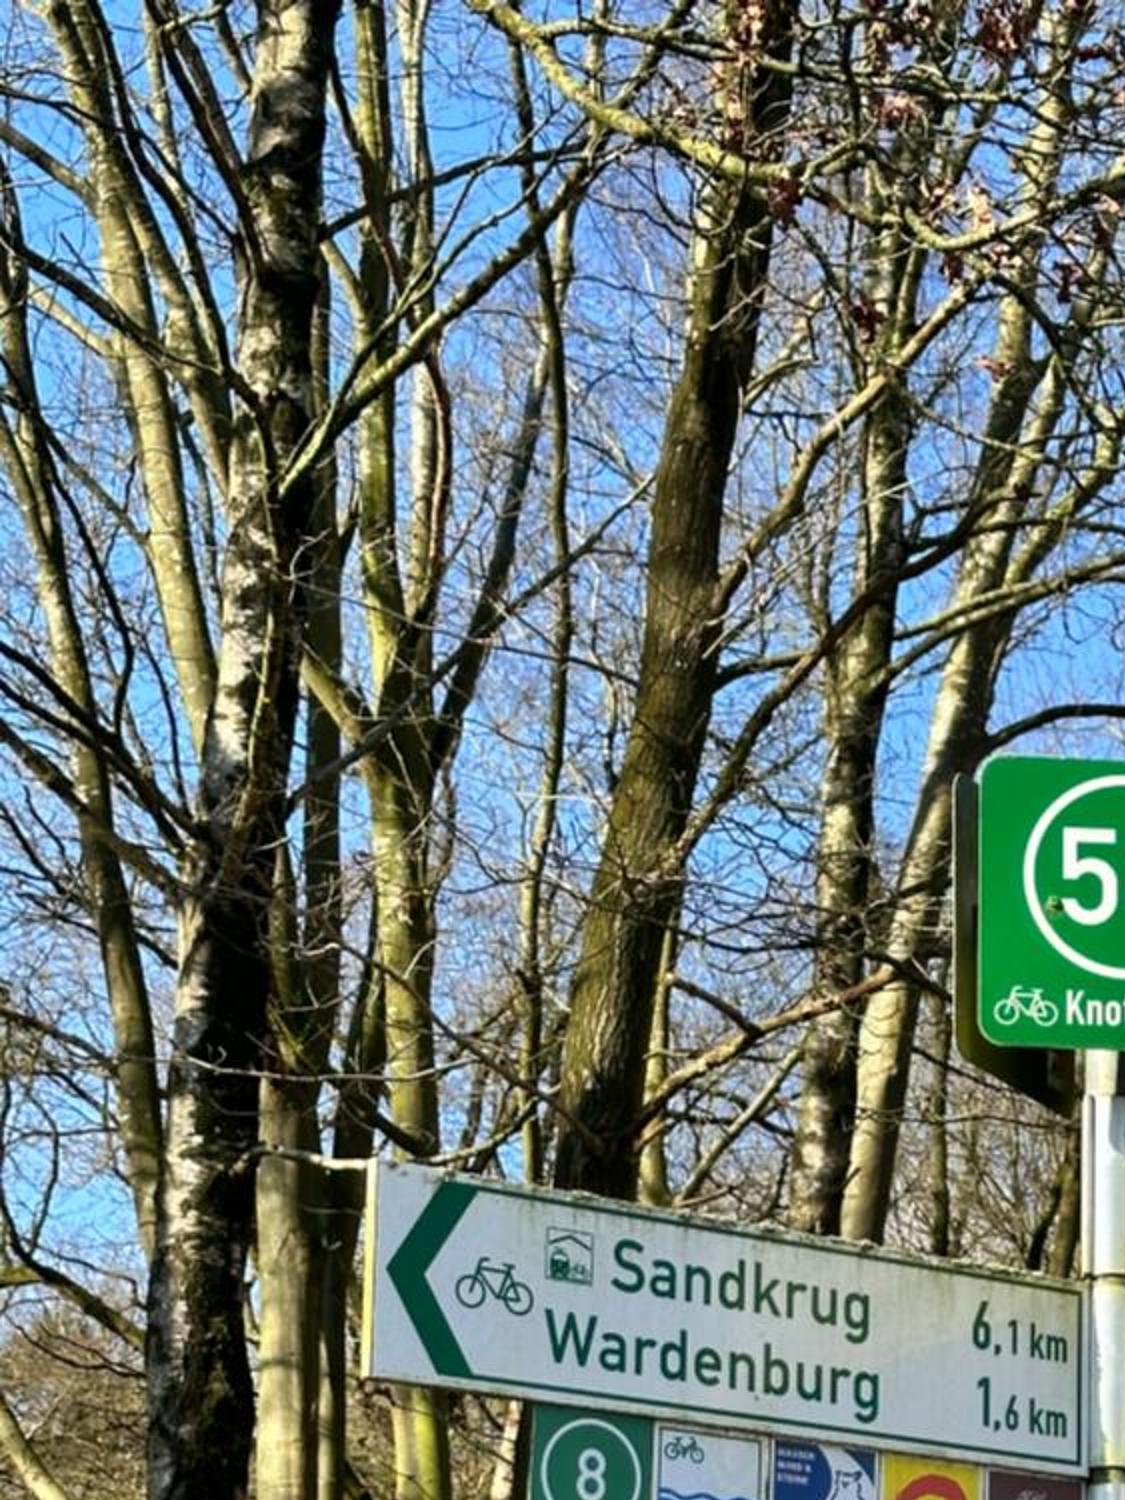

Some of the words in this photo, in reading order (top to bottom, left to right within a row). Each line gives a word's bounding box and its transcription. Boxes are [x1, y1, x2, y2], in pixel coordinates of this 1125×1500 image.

[611, 1240, 869, 1344] Sandkrug
[973, 1301, 1017, 1355] 6,1
[1030, 1325, 1067, 1363] km
[545, 1309, 878, 1423] Wardenburg
[978, 1377, 1019, 1431] 1,6
[1030, 1400, 1067, 1438] km
